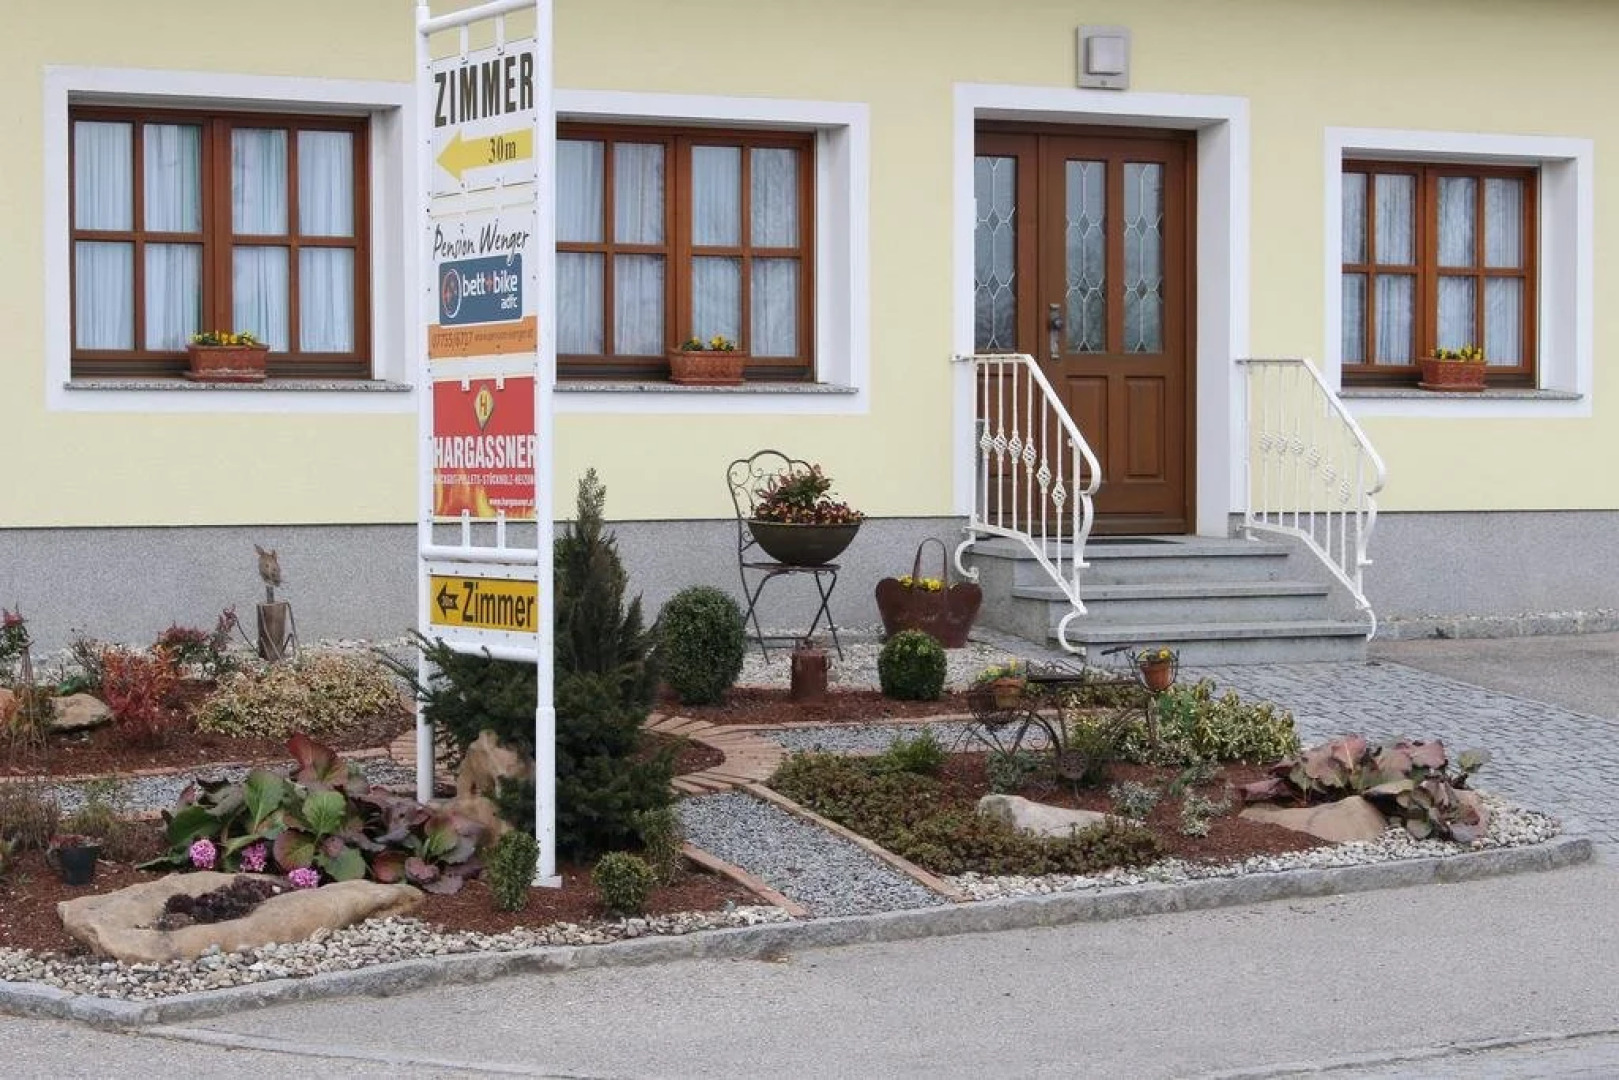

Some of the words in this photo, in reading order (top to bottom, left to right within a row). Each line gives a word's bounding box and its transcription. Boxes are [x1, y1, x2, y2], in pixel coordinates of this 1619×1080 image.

[434, 52, 534, 128] ZIMMER
[488, 136, 517, 164] 30m
[433, 222, 475, 261] Pension
[480, 218, 531, 266] Wenger
[433, 434, 536, 469] HARGASSNER
[462, 581, 535, 628] Zimmer
